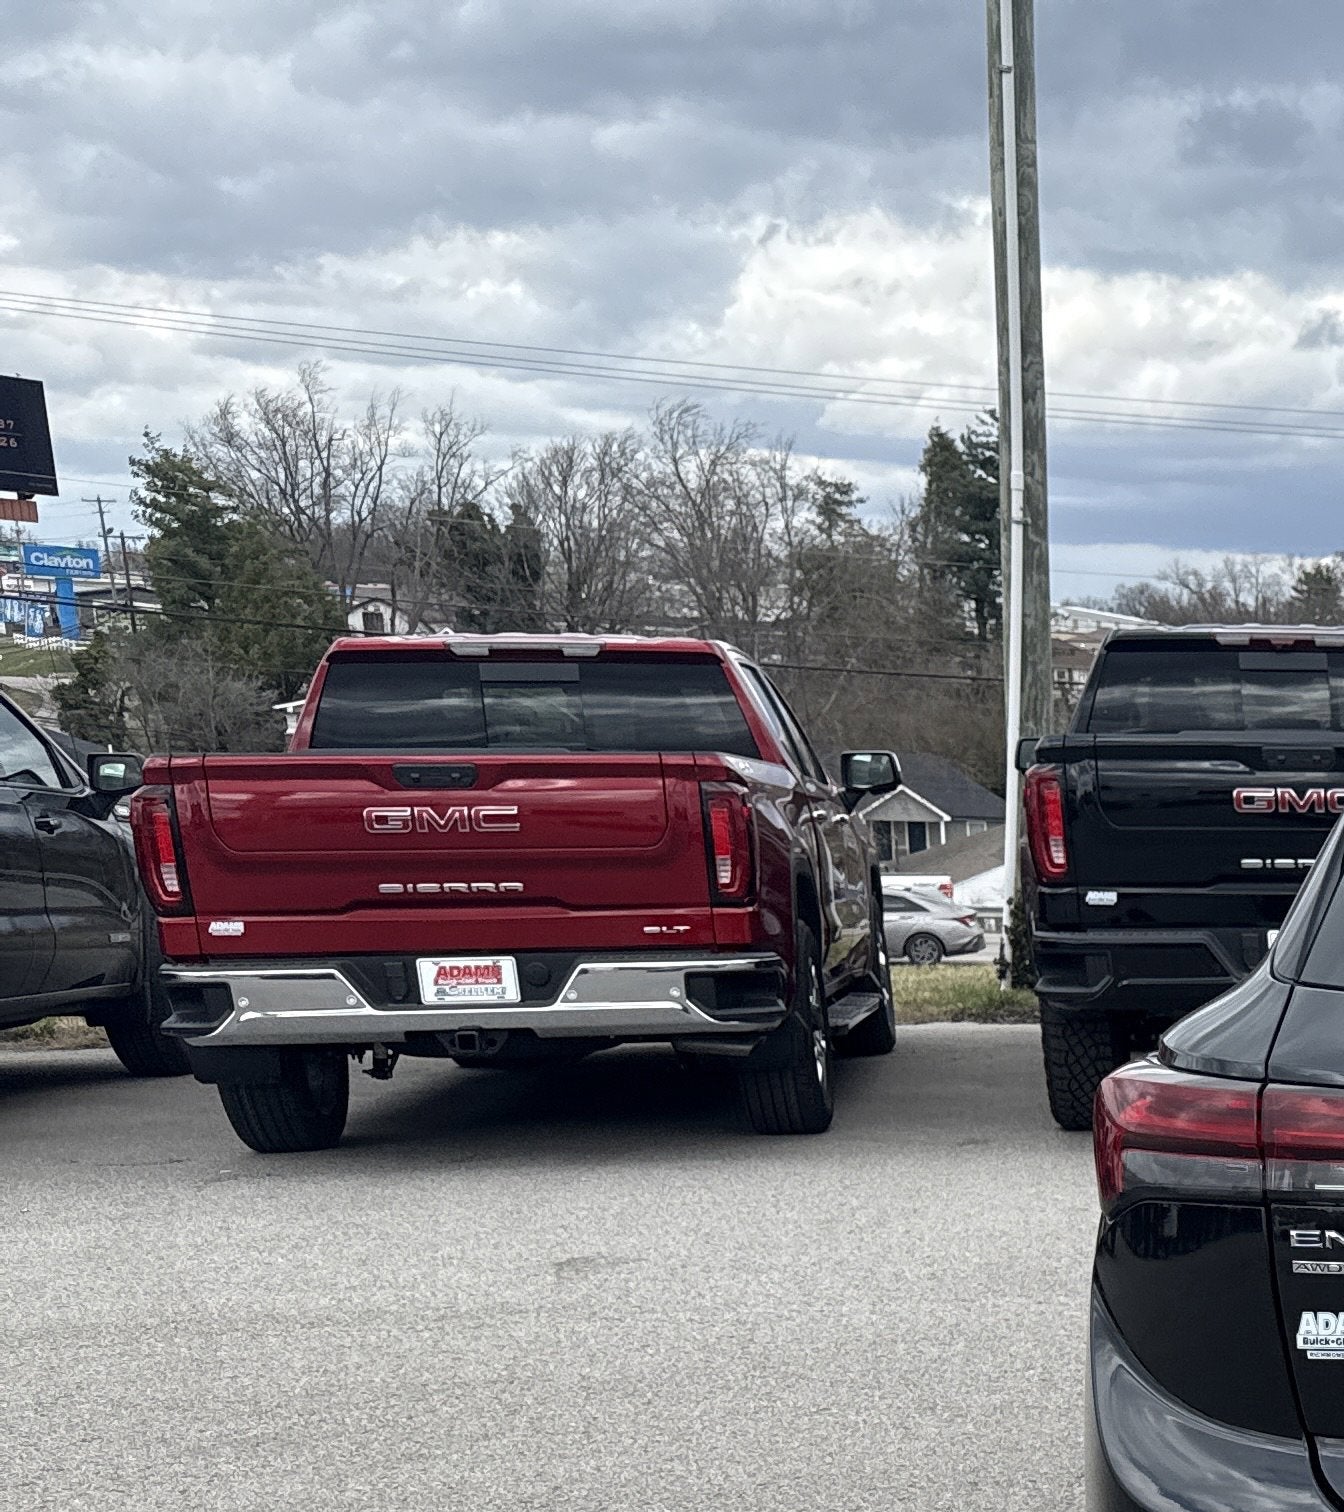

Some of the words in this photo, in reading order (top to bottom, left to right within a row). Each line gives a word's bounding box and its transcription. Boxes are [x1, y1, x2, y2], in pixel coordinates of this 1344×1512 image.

[30, 551, 94, 570] Clayton
[363, 805, 521, 833] GMC
[378, 882, 524, 893] SIERRA
[1293, 1262, 1343, 1274] AWD
